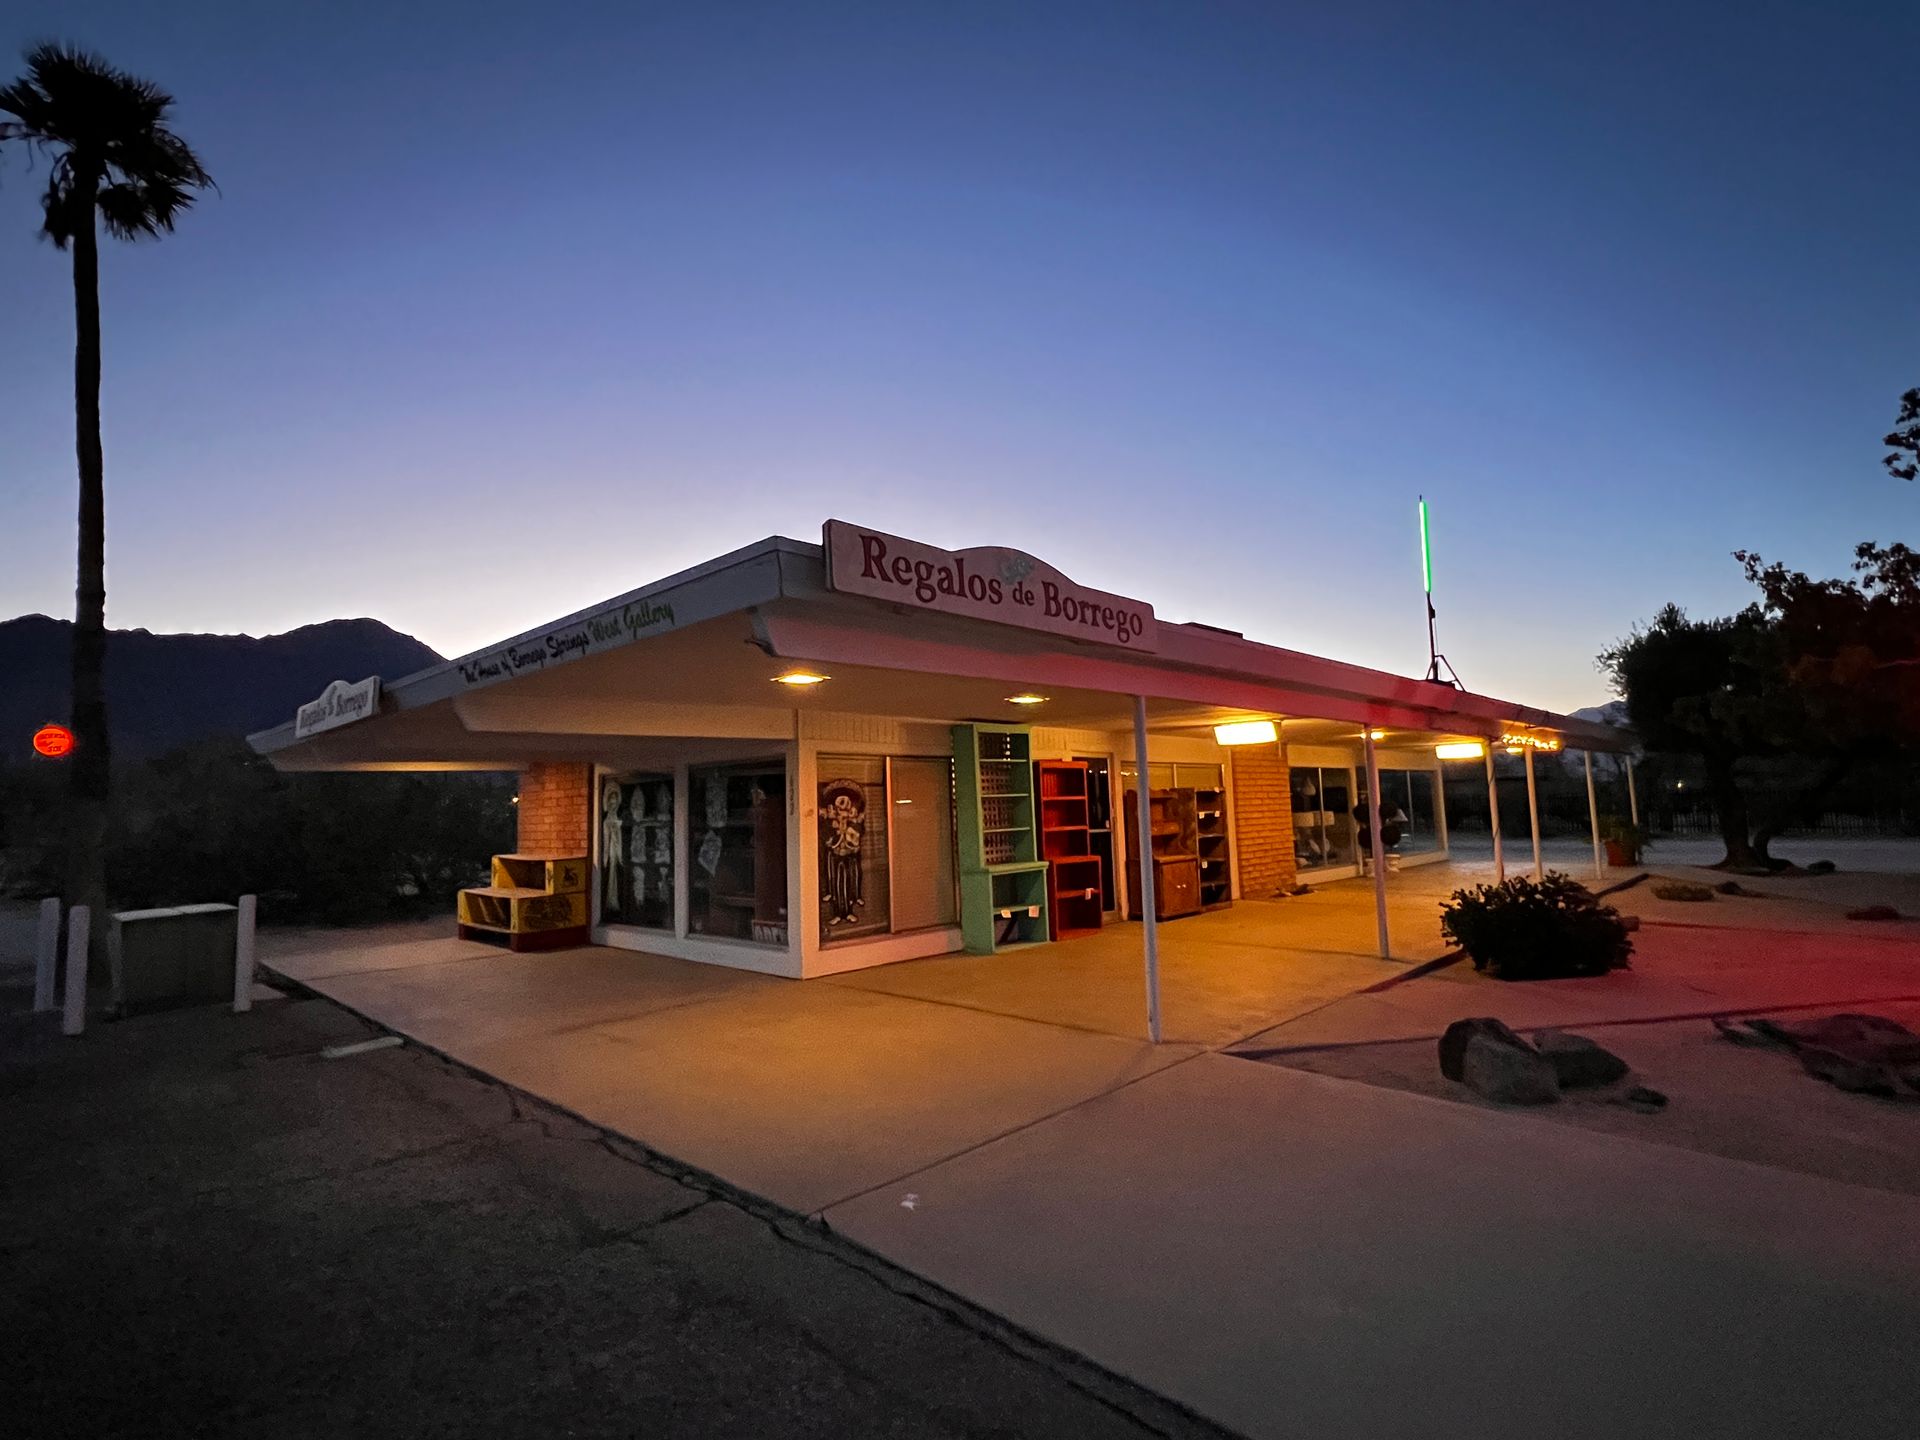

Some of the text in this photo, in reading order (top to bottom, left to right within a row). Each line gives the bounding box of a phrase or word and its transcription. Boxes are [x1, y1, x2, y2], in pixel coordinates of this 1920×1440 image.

[858, 534, 1143, 644] Regalos de Borrego
[508, 647, 547, 669] Borrego
[545, 632, 591, 659] Springs
[586, 614, 623, 643] West
[623, 602, 675, 640] Gallery
